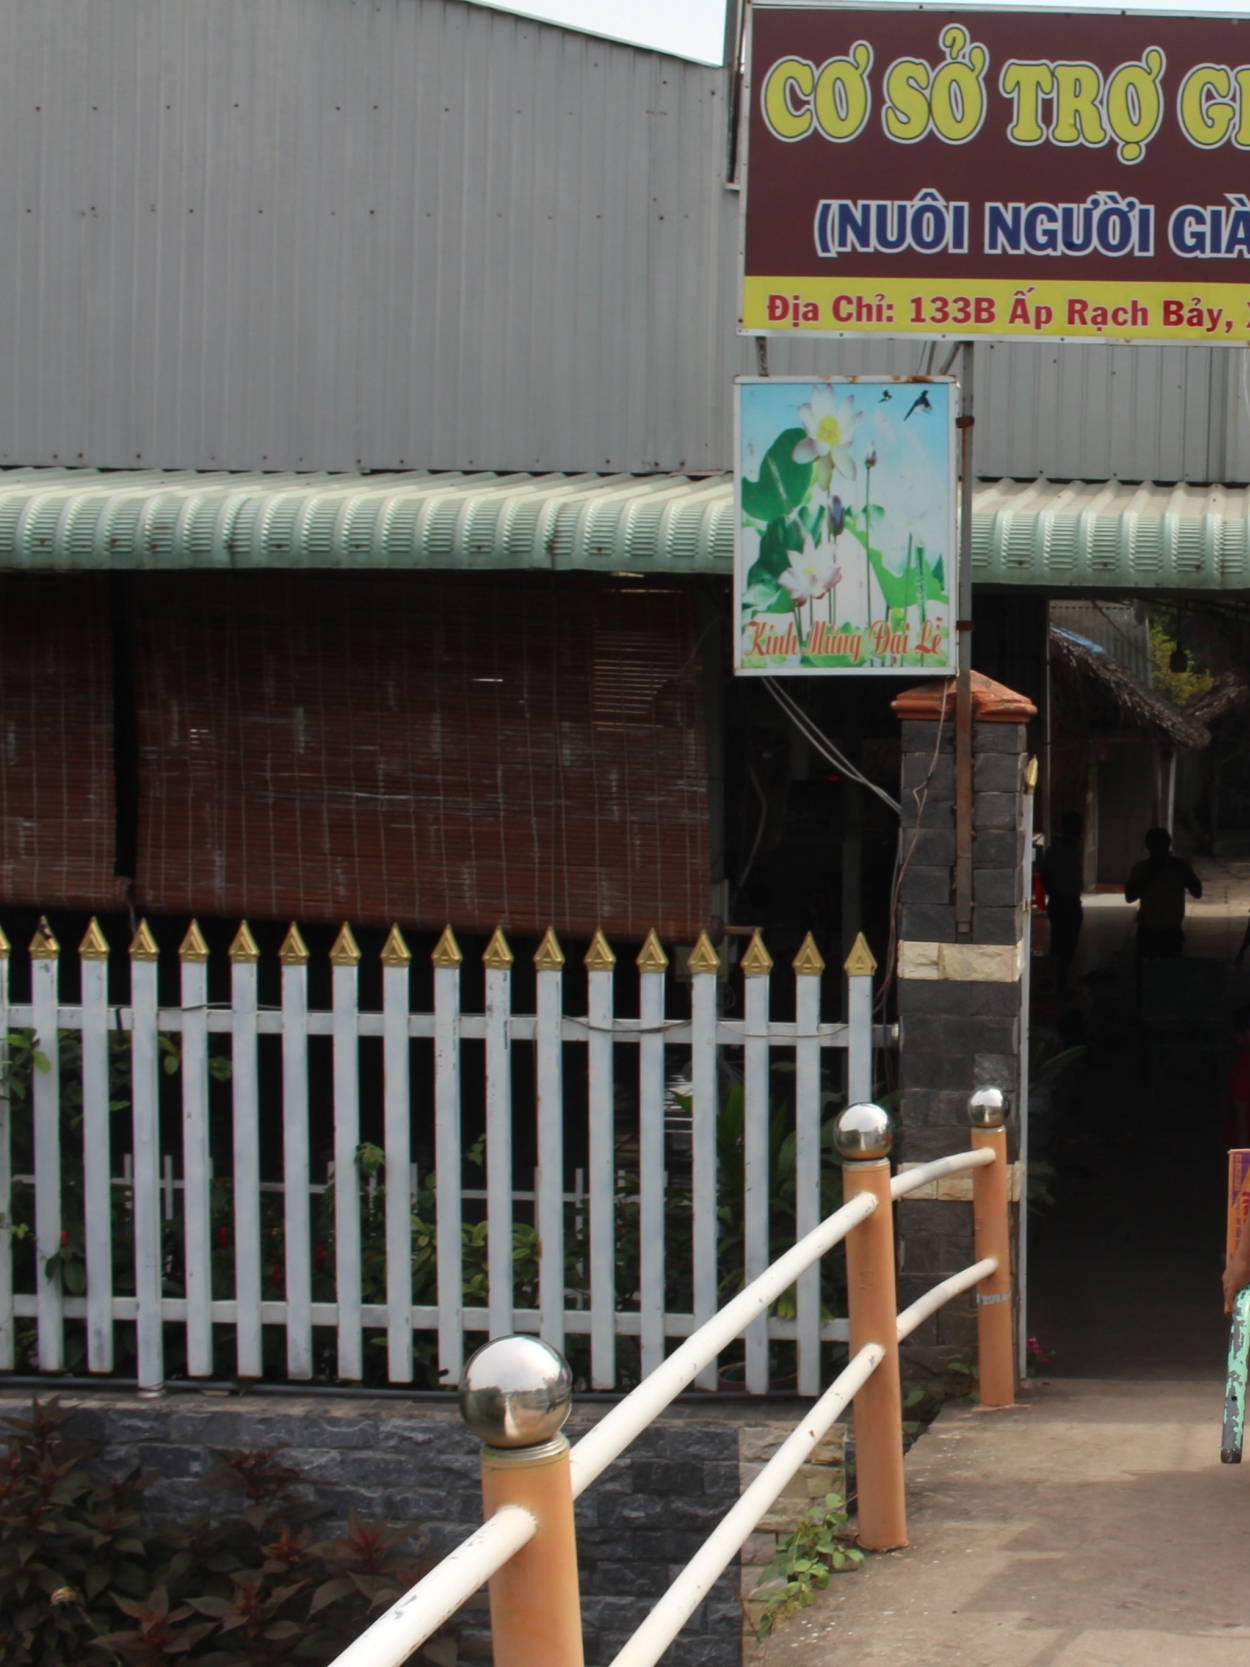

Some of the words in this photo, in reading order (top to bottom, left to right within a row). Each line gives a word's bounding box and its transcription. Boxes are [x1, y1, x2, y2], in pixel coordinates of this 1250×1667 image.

[761, 40, 874, 143] CƠ
[881, 23, 990, 145] SỞ
[999, 45, 1166, 166] TRỢ
[814, 188, 969, 258] (NUÔI
[984, 190, 1155, 258] NGƯỜI
[767, 294, 821, 328] Địa
[832, 292, 895, 324] Chỉ:
[910, 296, 995, 325] 133B
[1007, 287, 1055, 331] Ấp
[1066, 297, 1149, 332] Rạch
[1162, 297, 1234, 334] Bảy,
[746, 620, 798, 656] Kính
[869, 619, 911, 664] Đại
